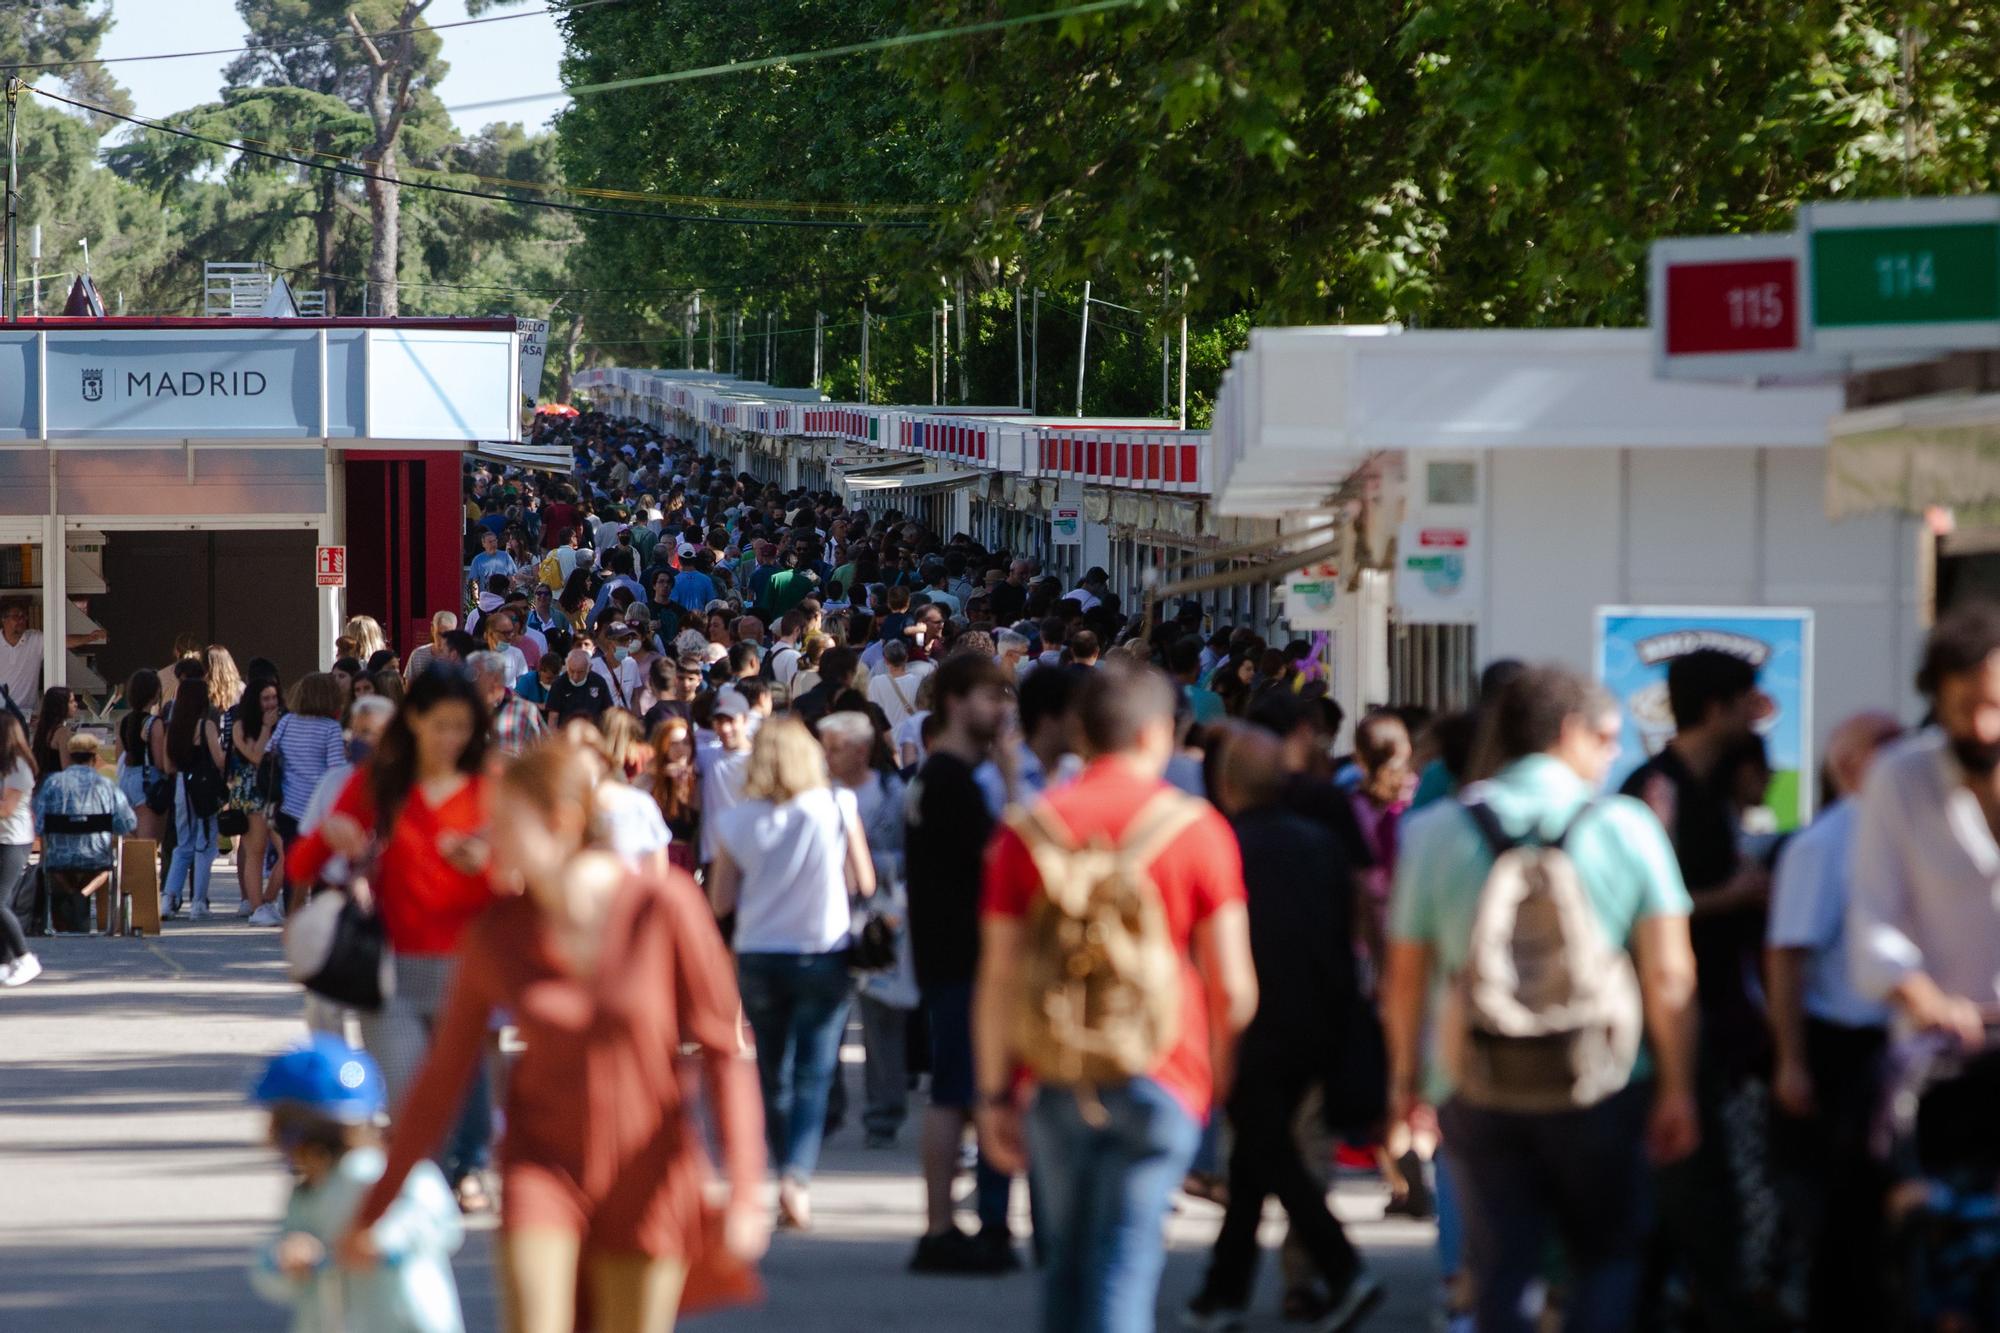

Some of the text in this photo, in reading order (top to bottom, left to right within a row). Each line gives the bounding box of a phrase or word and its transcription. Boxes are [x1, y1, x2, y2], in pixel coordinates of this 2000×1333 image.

[1876, 252, 1934, 297] 114
[1727, 282, 1784, 329] 115
[520, 344, 542, 356] ASA
[127, 371, 267, 397] MADRID
